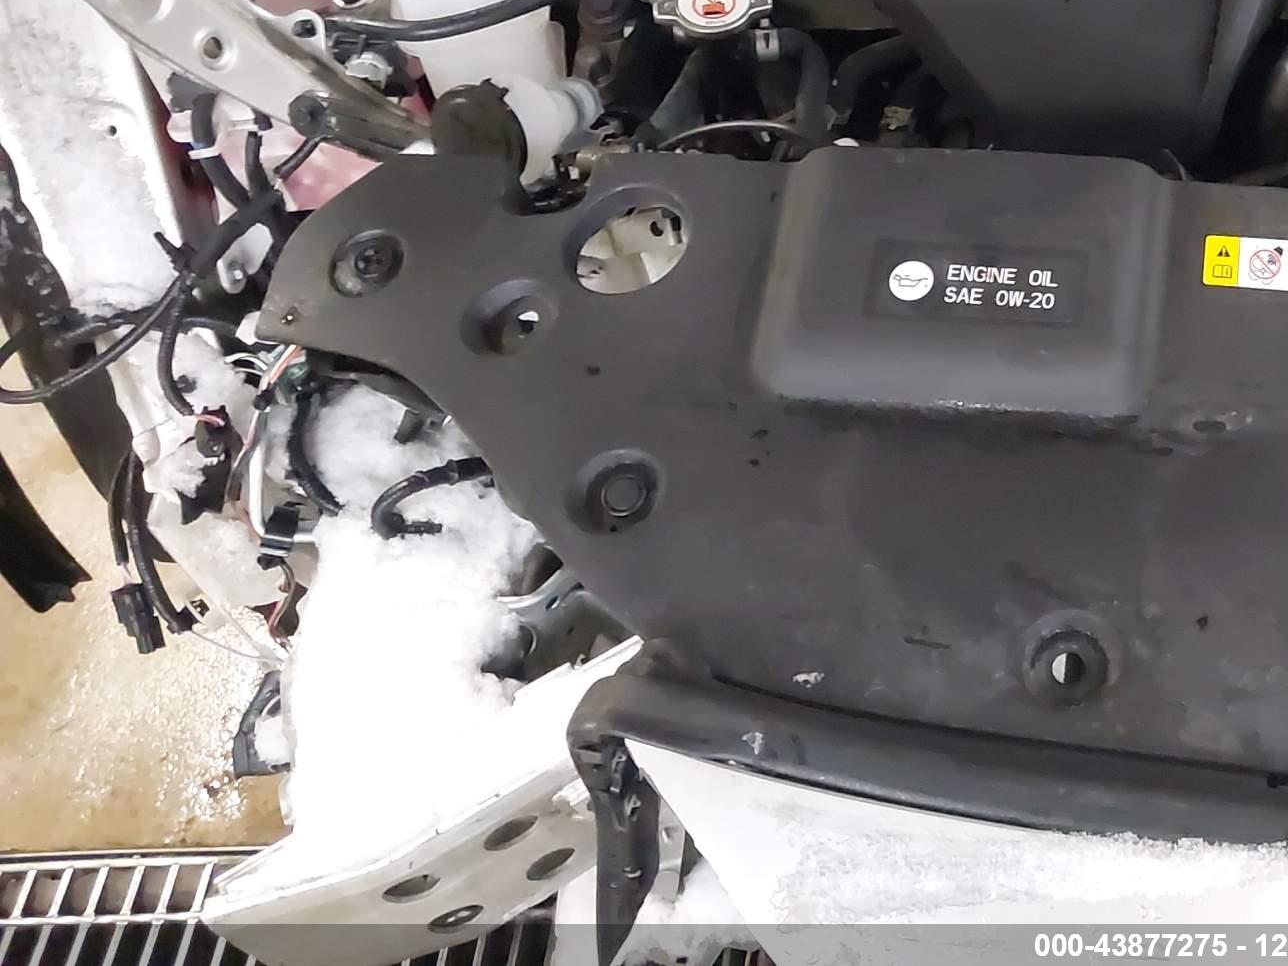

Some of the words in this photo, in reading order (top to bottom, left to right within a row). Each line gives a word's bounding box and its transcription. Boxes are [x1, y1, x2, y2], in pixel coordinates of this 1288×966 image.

[947, 265, 1017, 284] ENGINE
[1029, 270, 1058, 287] OIL
[944, 287, 984, 304] SAE
[996, 290, 1054, 308] 0W-20
